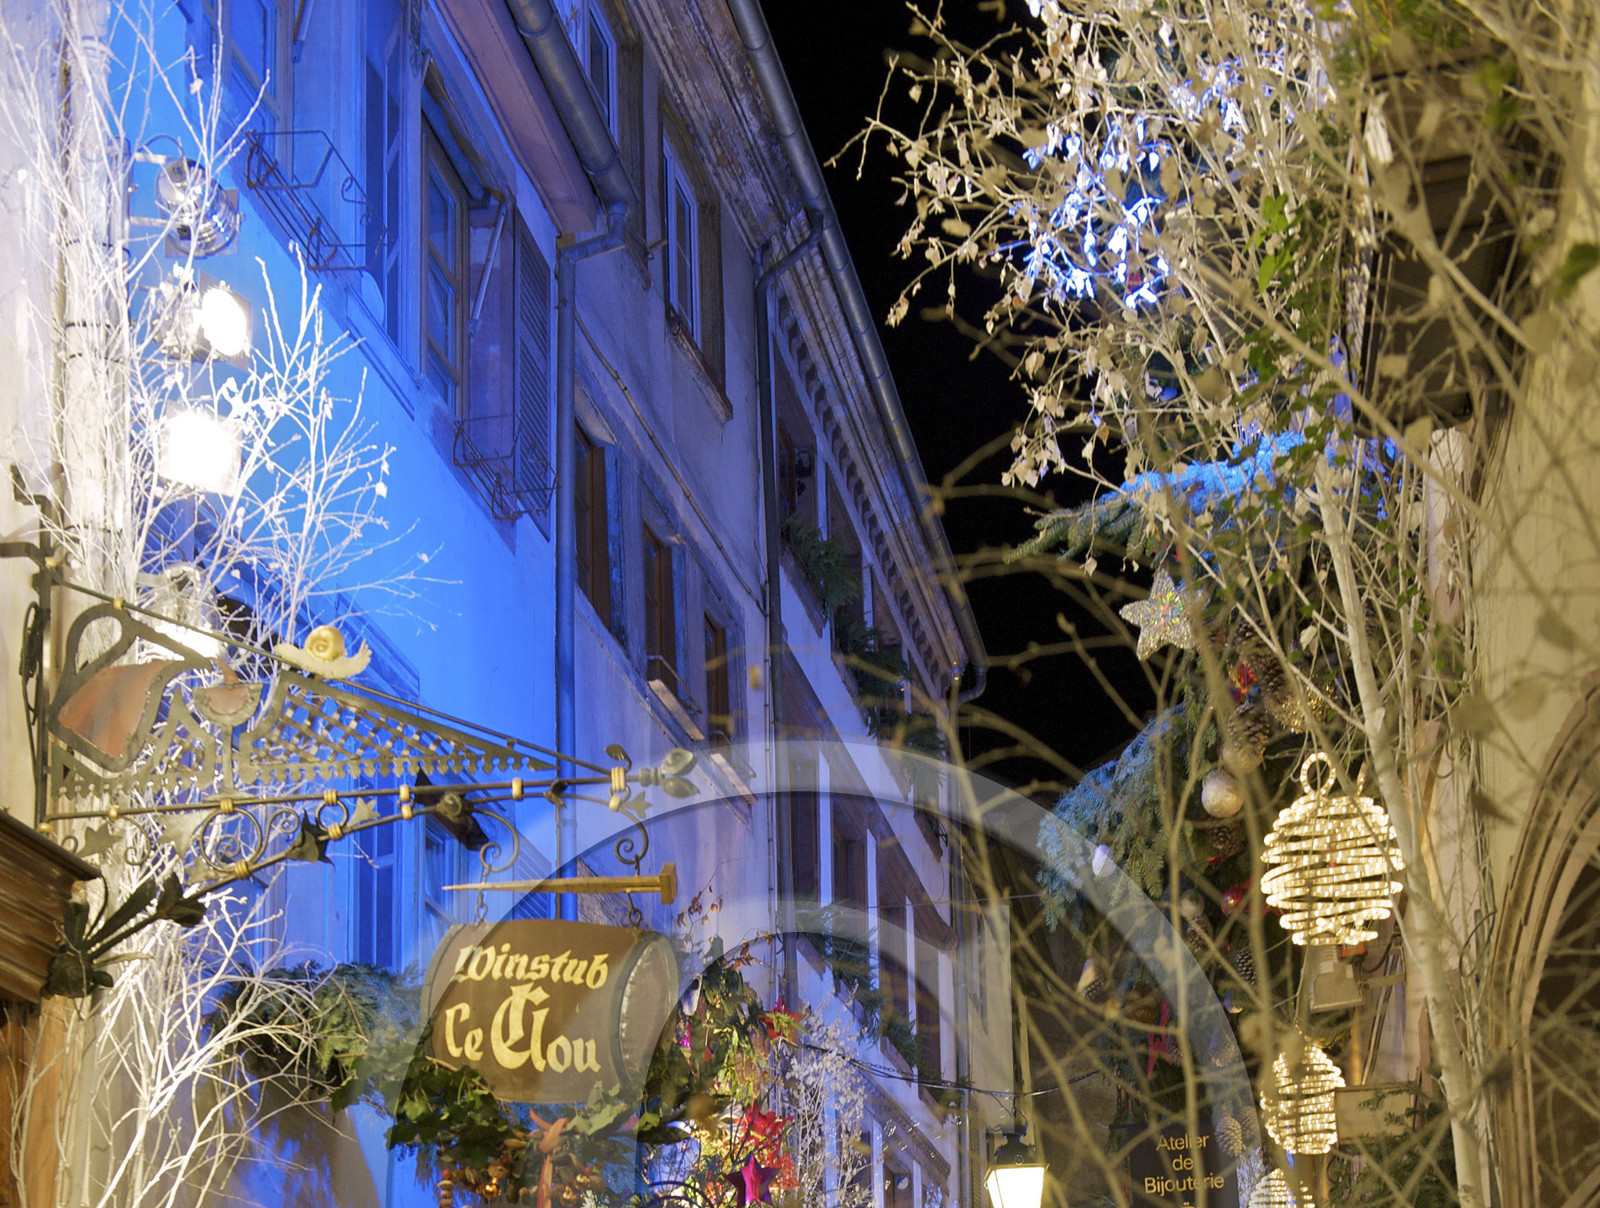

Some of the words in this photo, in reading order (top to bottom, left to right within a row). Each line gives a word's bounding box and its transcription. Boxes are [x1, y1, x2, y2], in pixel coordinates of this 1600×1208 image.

[454, 943, 609, 990] Winstub
[490, 982, 602, 1073] Clou
[1172, 1154, 1194, 1171] de
[1144, 1172, 1225, 1197] Bijouterie
